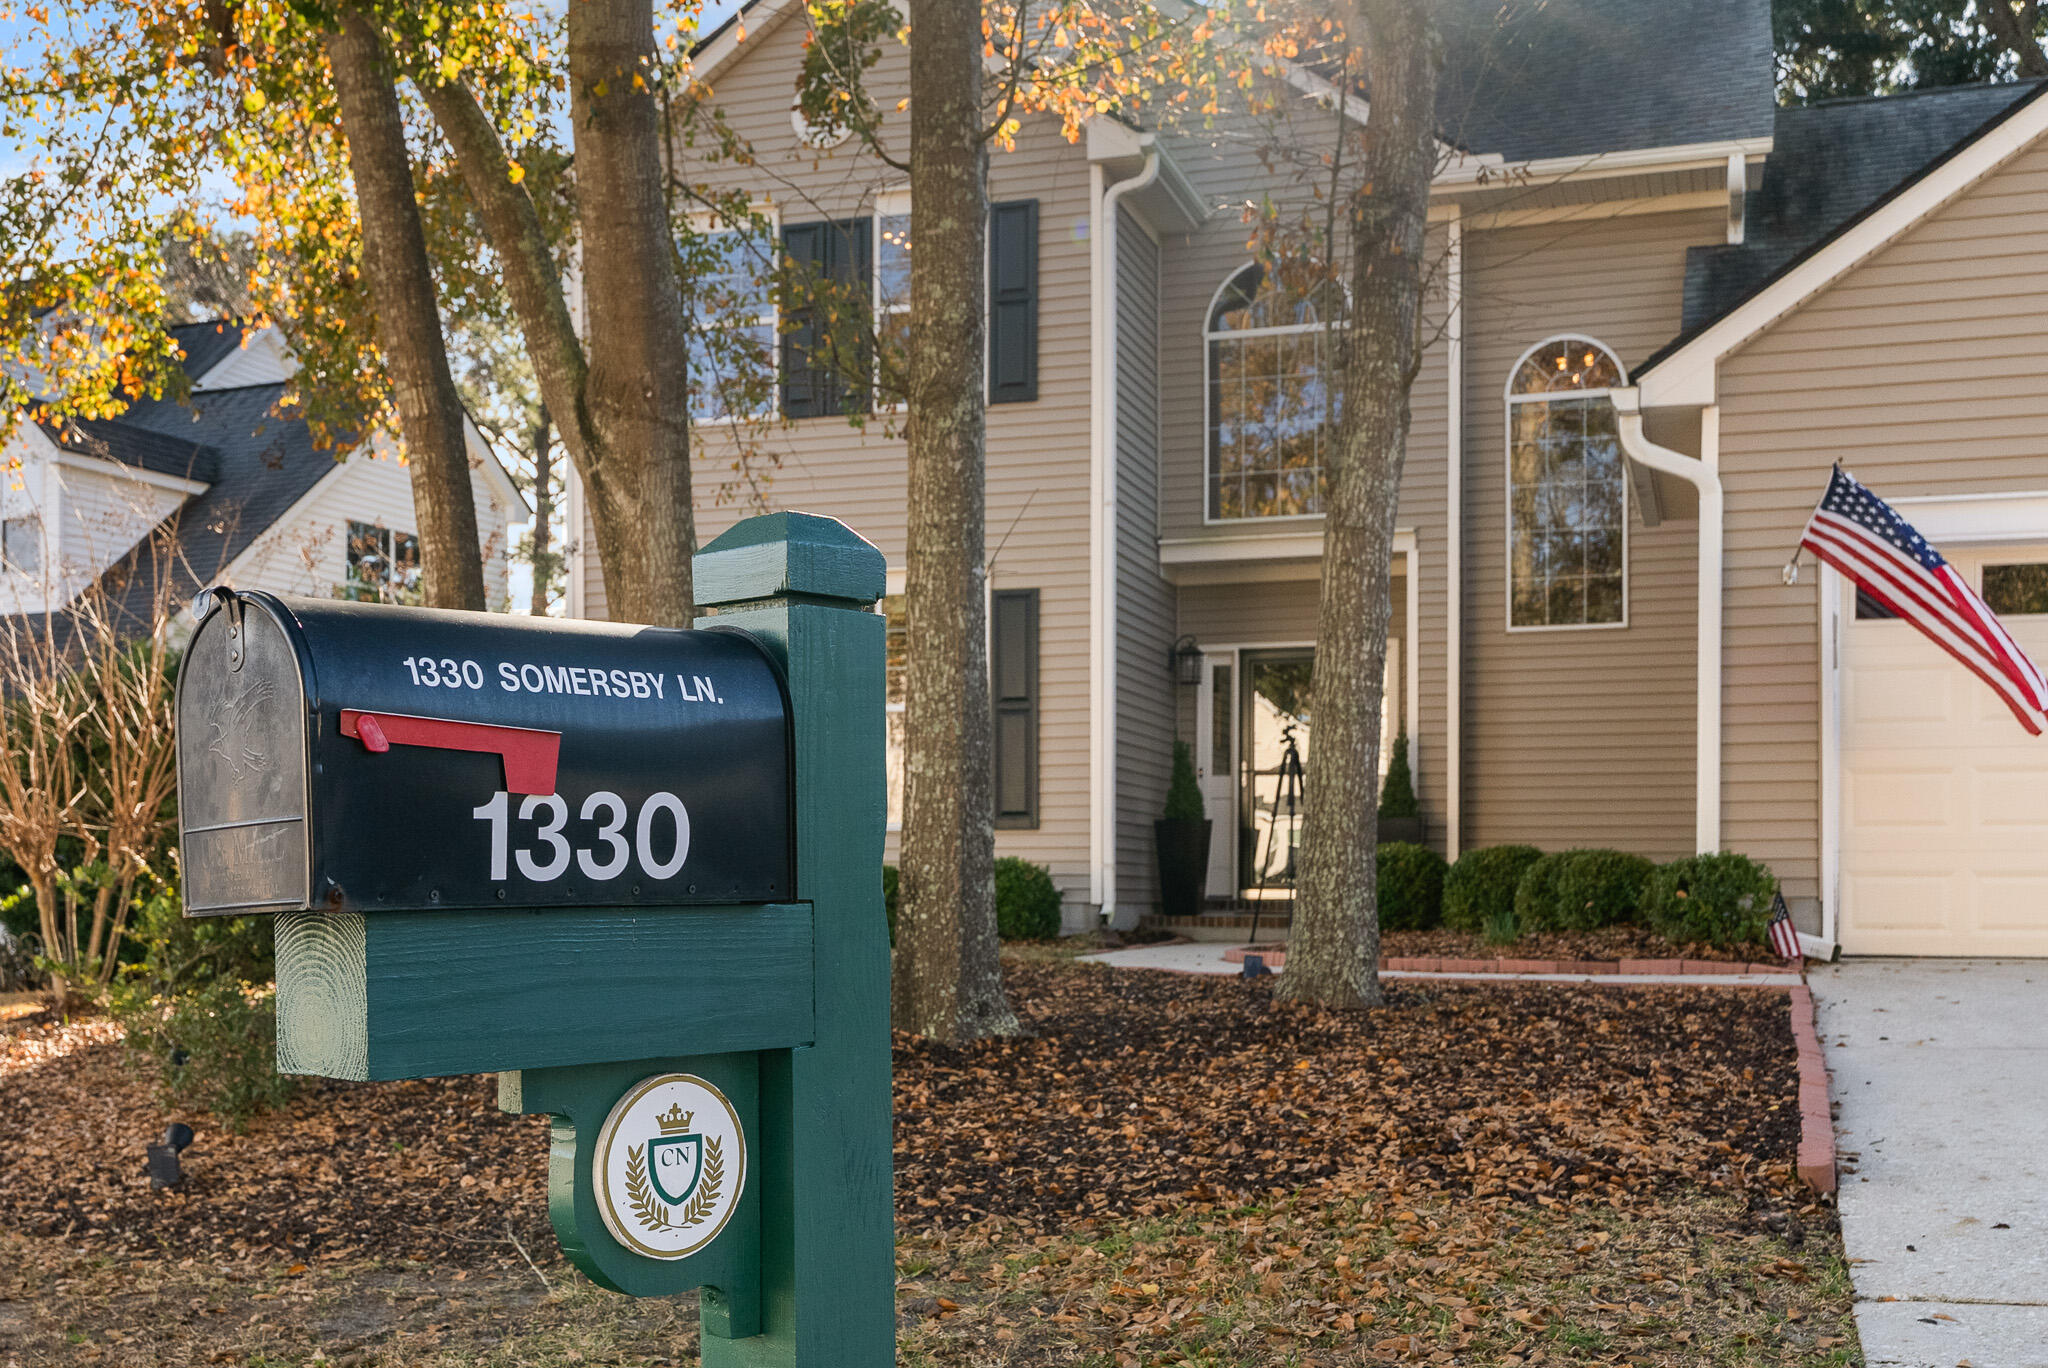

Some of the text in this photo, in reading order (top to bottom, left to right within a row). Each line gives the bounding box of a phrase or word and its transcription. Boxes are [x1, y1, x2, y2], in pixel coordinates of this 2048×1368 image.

[402, 656, 724, 705] 1330 SOMERSBY LN.
[473, 790, 690, 882] 1330
[661, 1146, 690, 1167] CN
